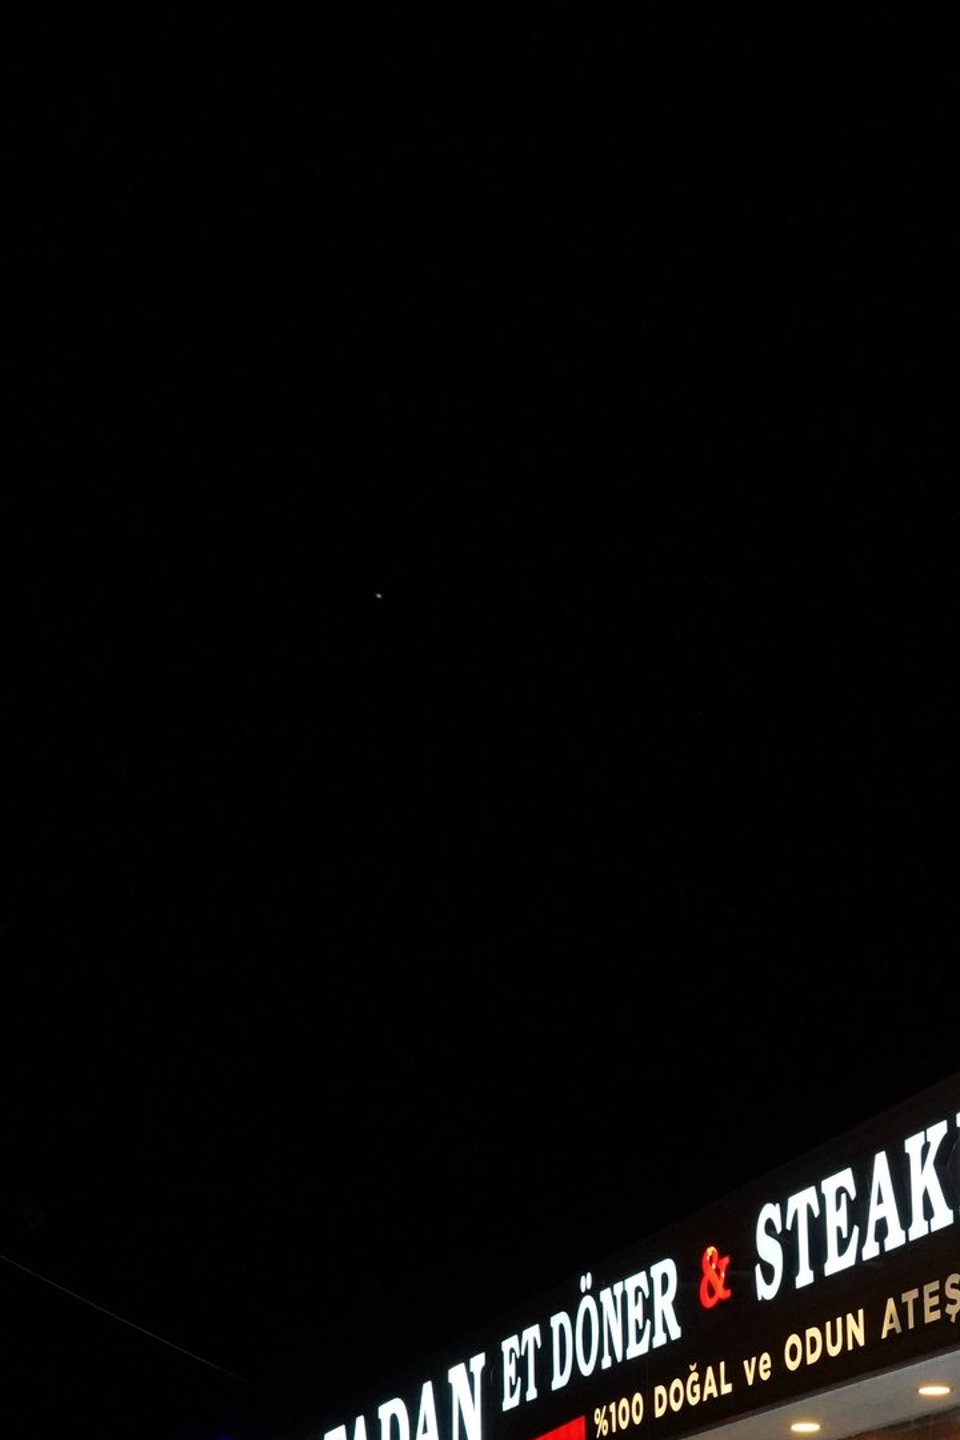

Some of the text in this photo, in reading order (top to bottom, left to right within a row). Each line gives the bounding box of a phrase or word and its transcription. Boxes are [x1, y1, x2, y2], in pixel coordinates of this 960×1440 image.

[501, 1324, 542, 1411] ET
[550, 1258, 682, 1391] DÖNER
[699, 1246, 731, 1309] &
[594, 1392, 644, 1438] %100
[654, 1361, 732, 1418] DOĞAL
[744, 1352, 771, 1386] ve
[784, 1308, 865, 1371] ODUN
